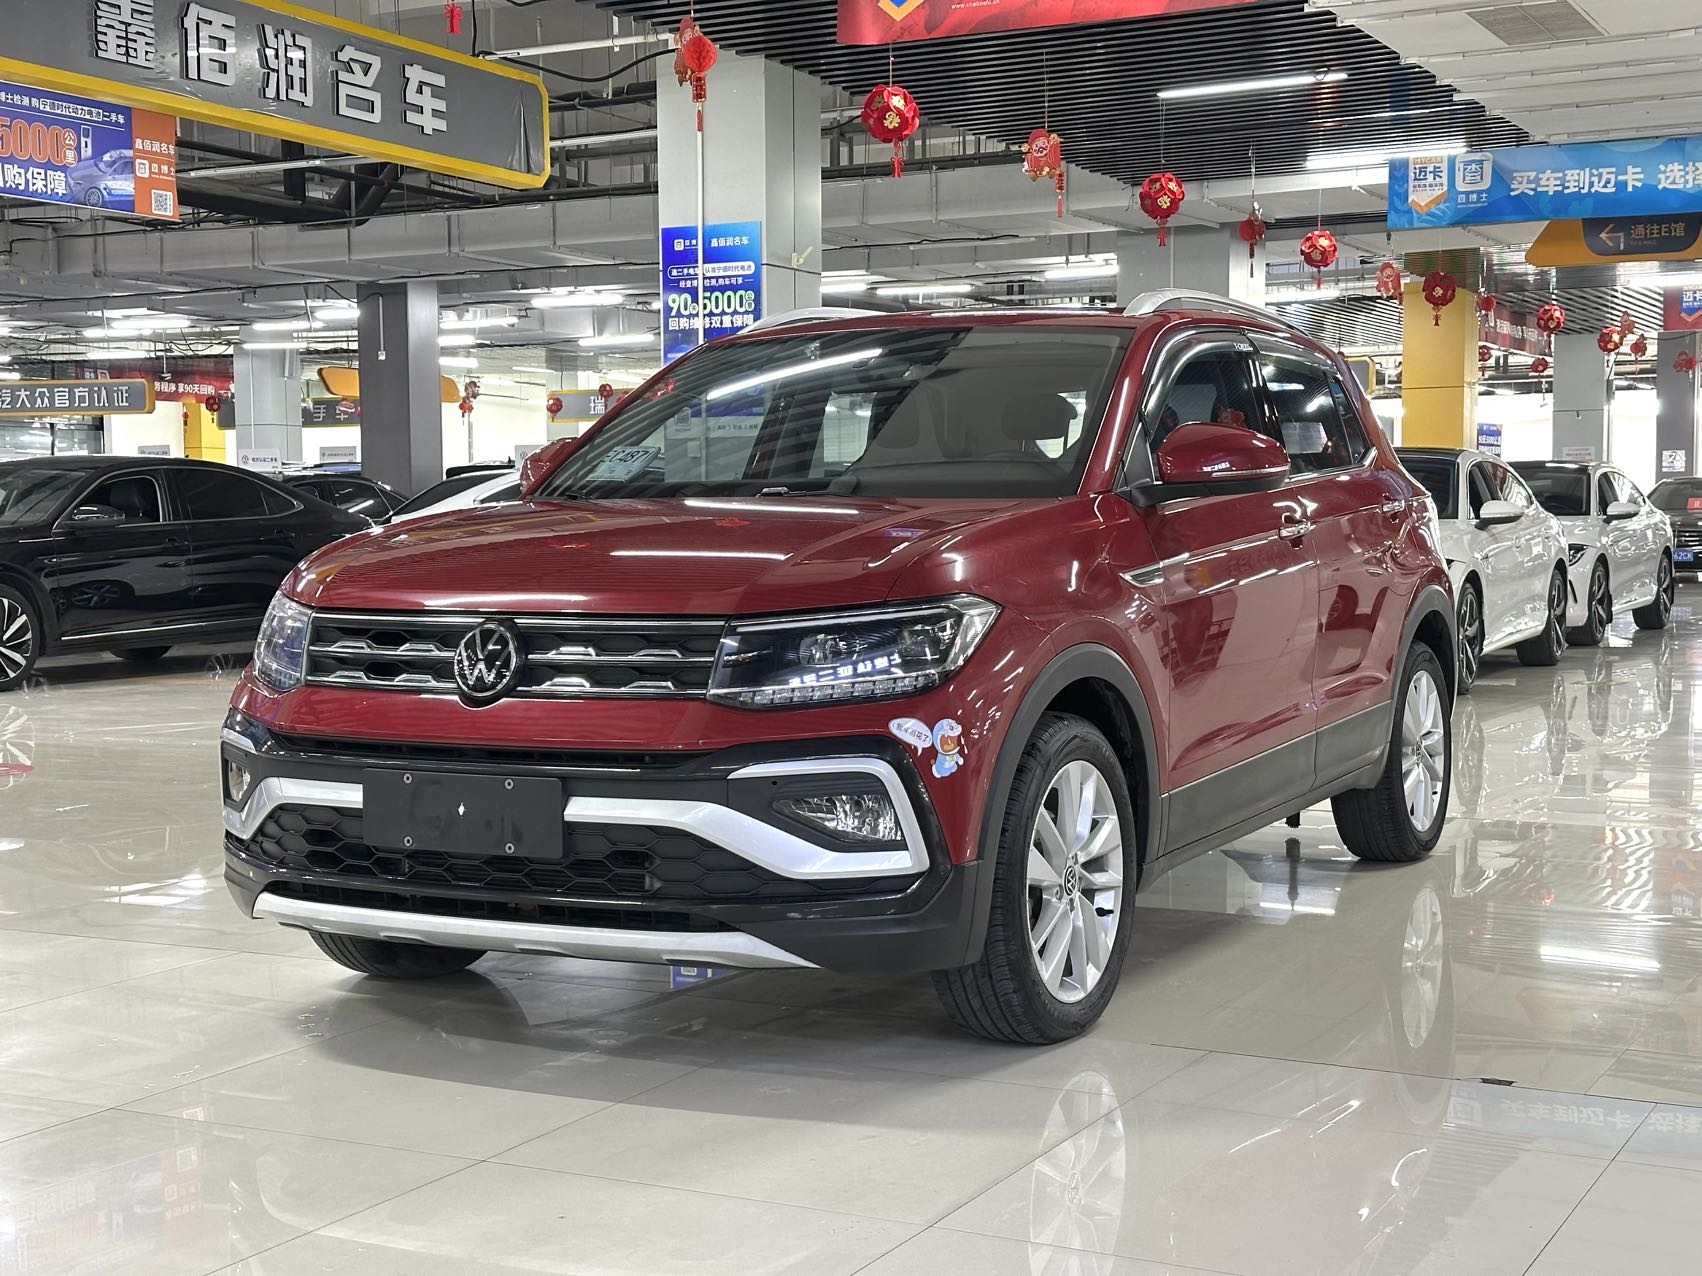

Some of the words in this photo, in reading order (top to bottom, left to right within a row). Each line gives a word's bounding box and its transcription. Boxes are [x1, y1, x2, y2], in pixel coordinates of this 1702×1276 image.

[95, 0, 447, 135] 鑫佰润名车
[103, 112, 125, 125] 二手车
[0, 162, 67, 197] 购保障
[1413, 165, 1443, 182] 迈卡
[1509, 164, 1644, 197] 买车到迈卡
[1630, 222, 1685, 239] 通往E馆
[710, 236, 749, 248] 鑫佰润名车
